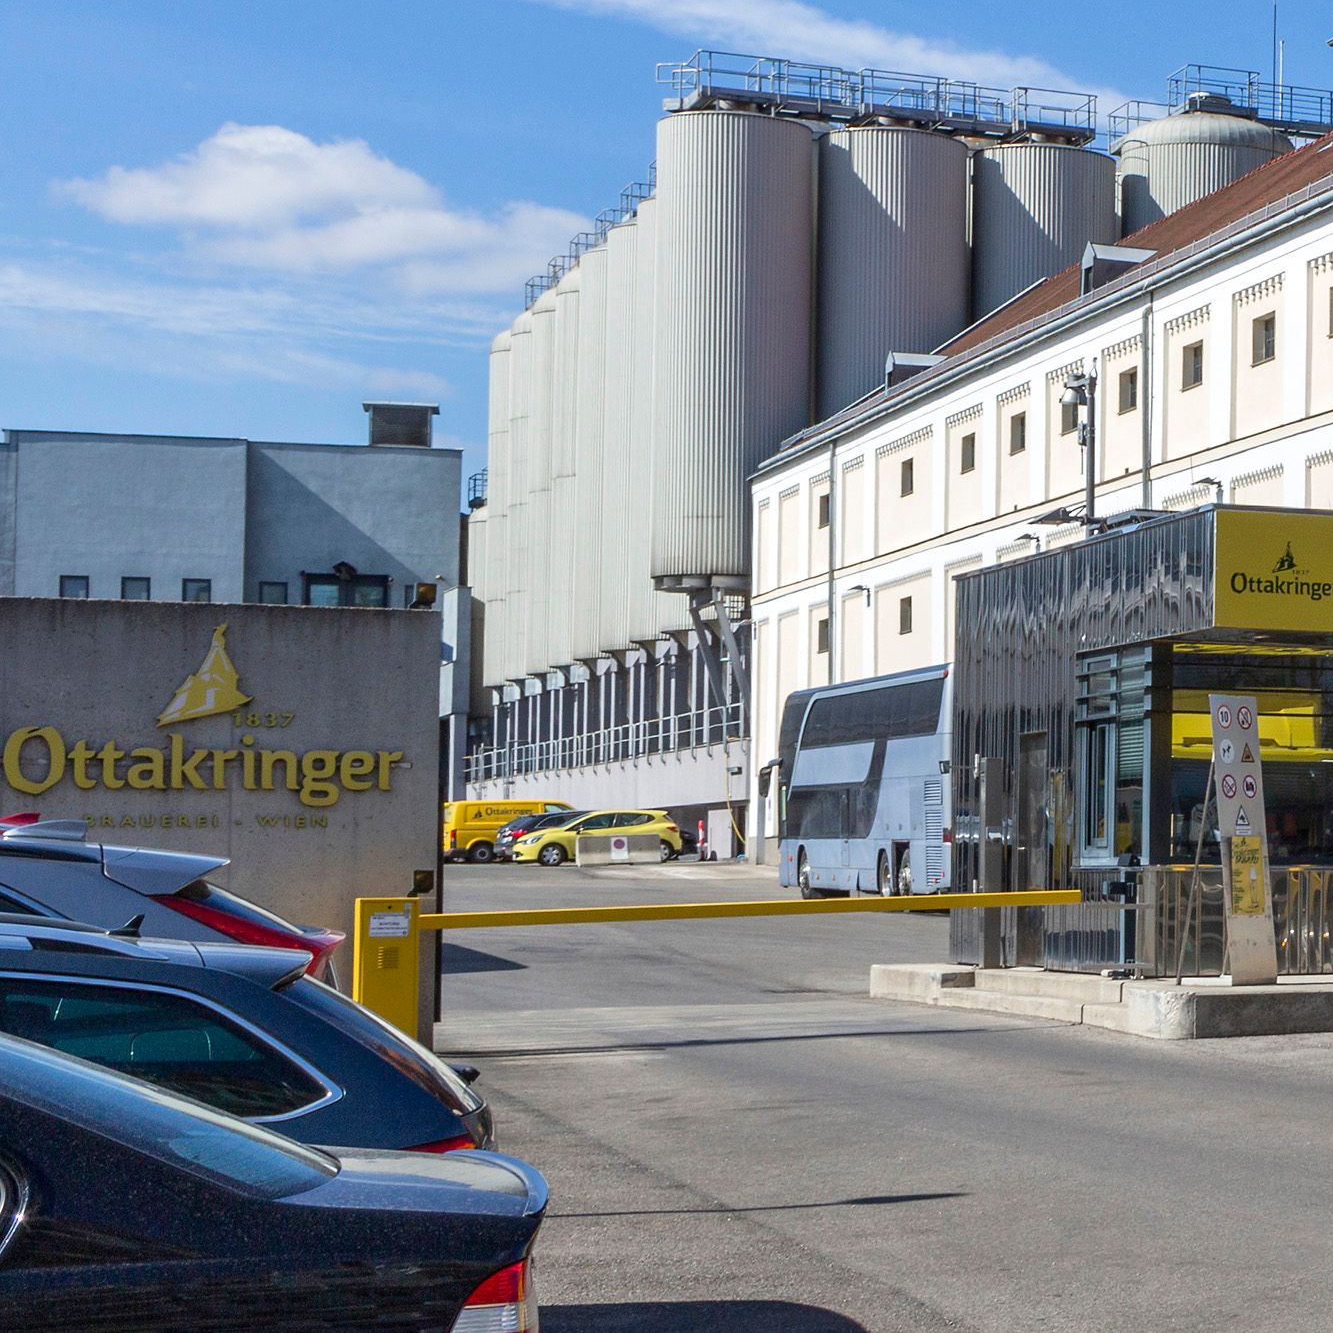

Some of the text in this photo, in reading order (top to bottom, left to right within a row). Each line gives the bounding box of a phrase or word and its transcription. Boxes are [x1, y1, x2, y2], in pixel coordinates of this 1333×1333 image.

[231, 712, 296, 729] 1837
[3, 725, 403, 807] Ottakringer
[84, 814, 221, 829] BRAUEREI
[257, 815, 329, 829] WIEN
